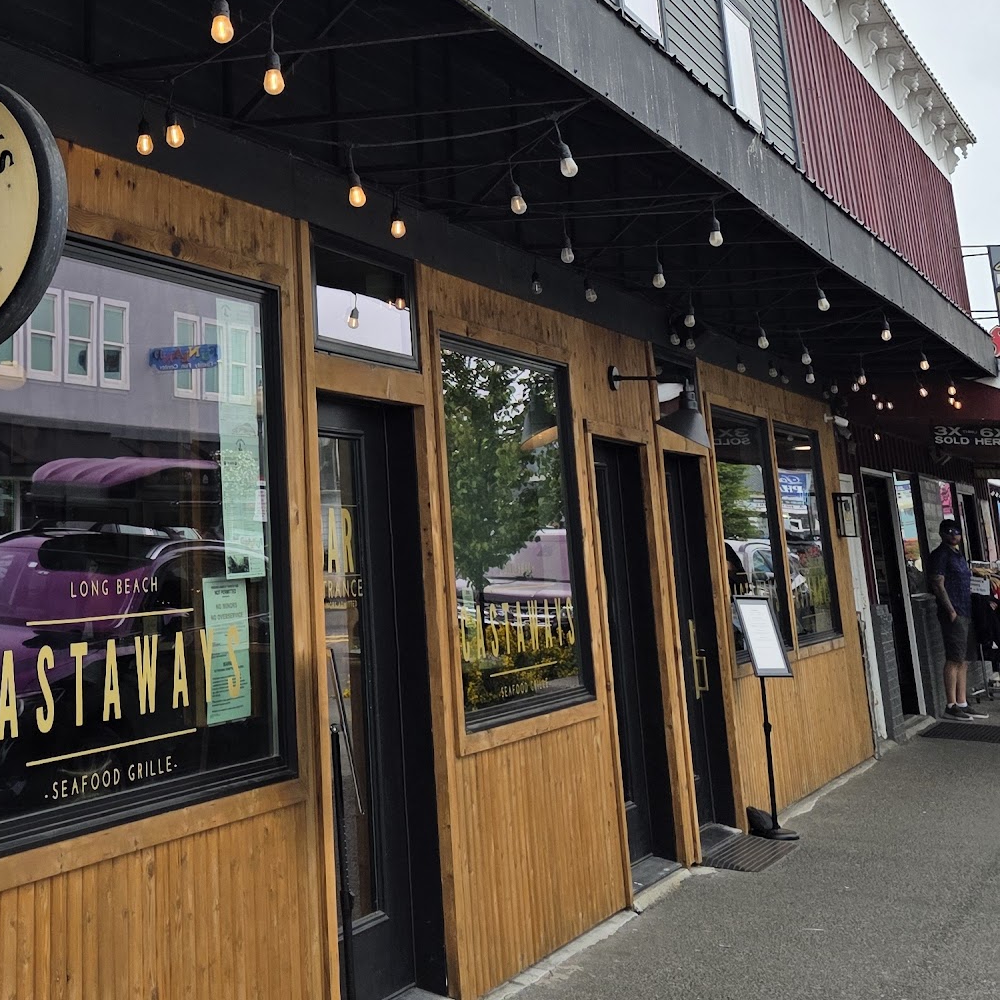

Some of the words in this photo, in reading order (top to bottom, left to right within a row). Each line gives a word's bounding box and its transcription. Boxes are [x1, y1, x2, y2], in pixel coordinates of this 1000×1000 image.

[934, 426, 962, 436] 3X
[934, 436, 970, 445] SOLD
[975, 437, 1000, 446] HER
[327, 507, 355, 574] AR
[70, 579, 109, 598] LONG
[116, 576, 159, 595] BEACH
[322, 579, 363, 598] TRANCE
[461, 596, 575, 662] CASTAWAYS
